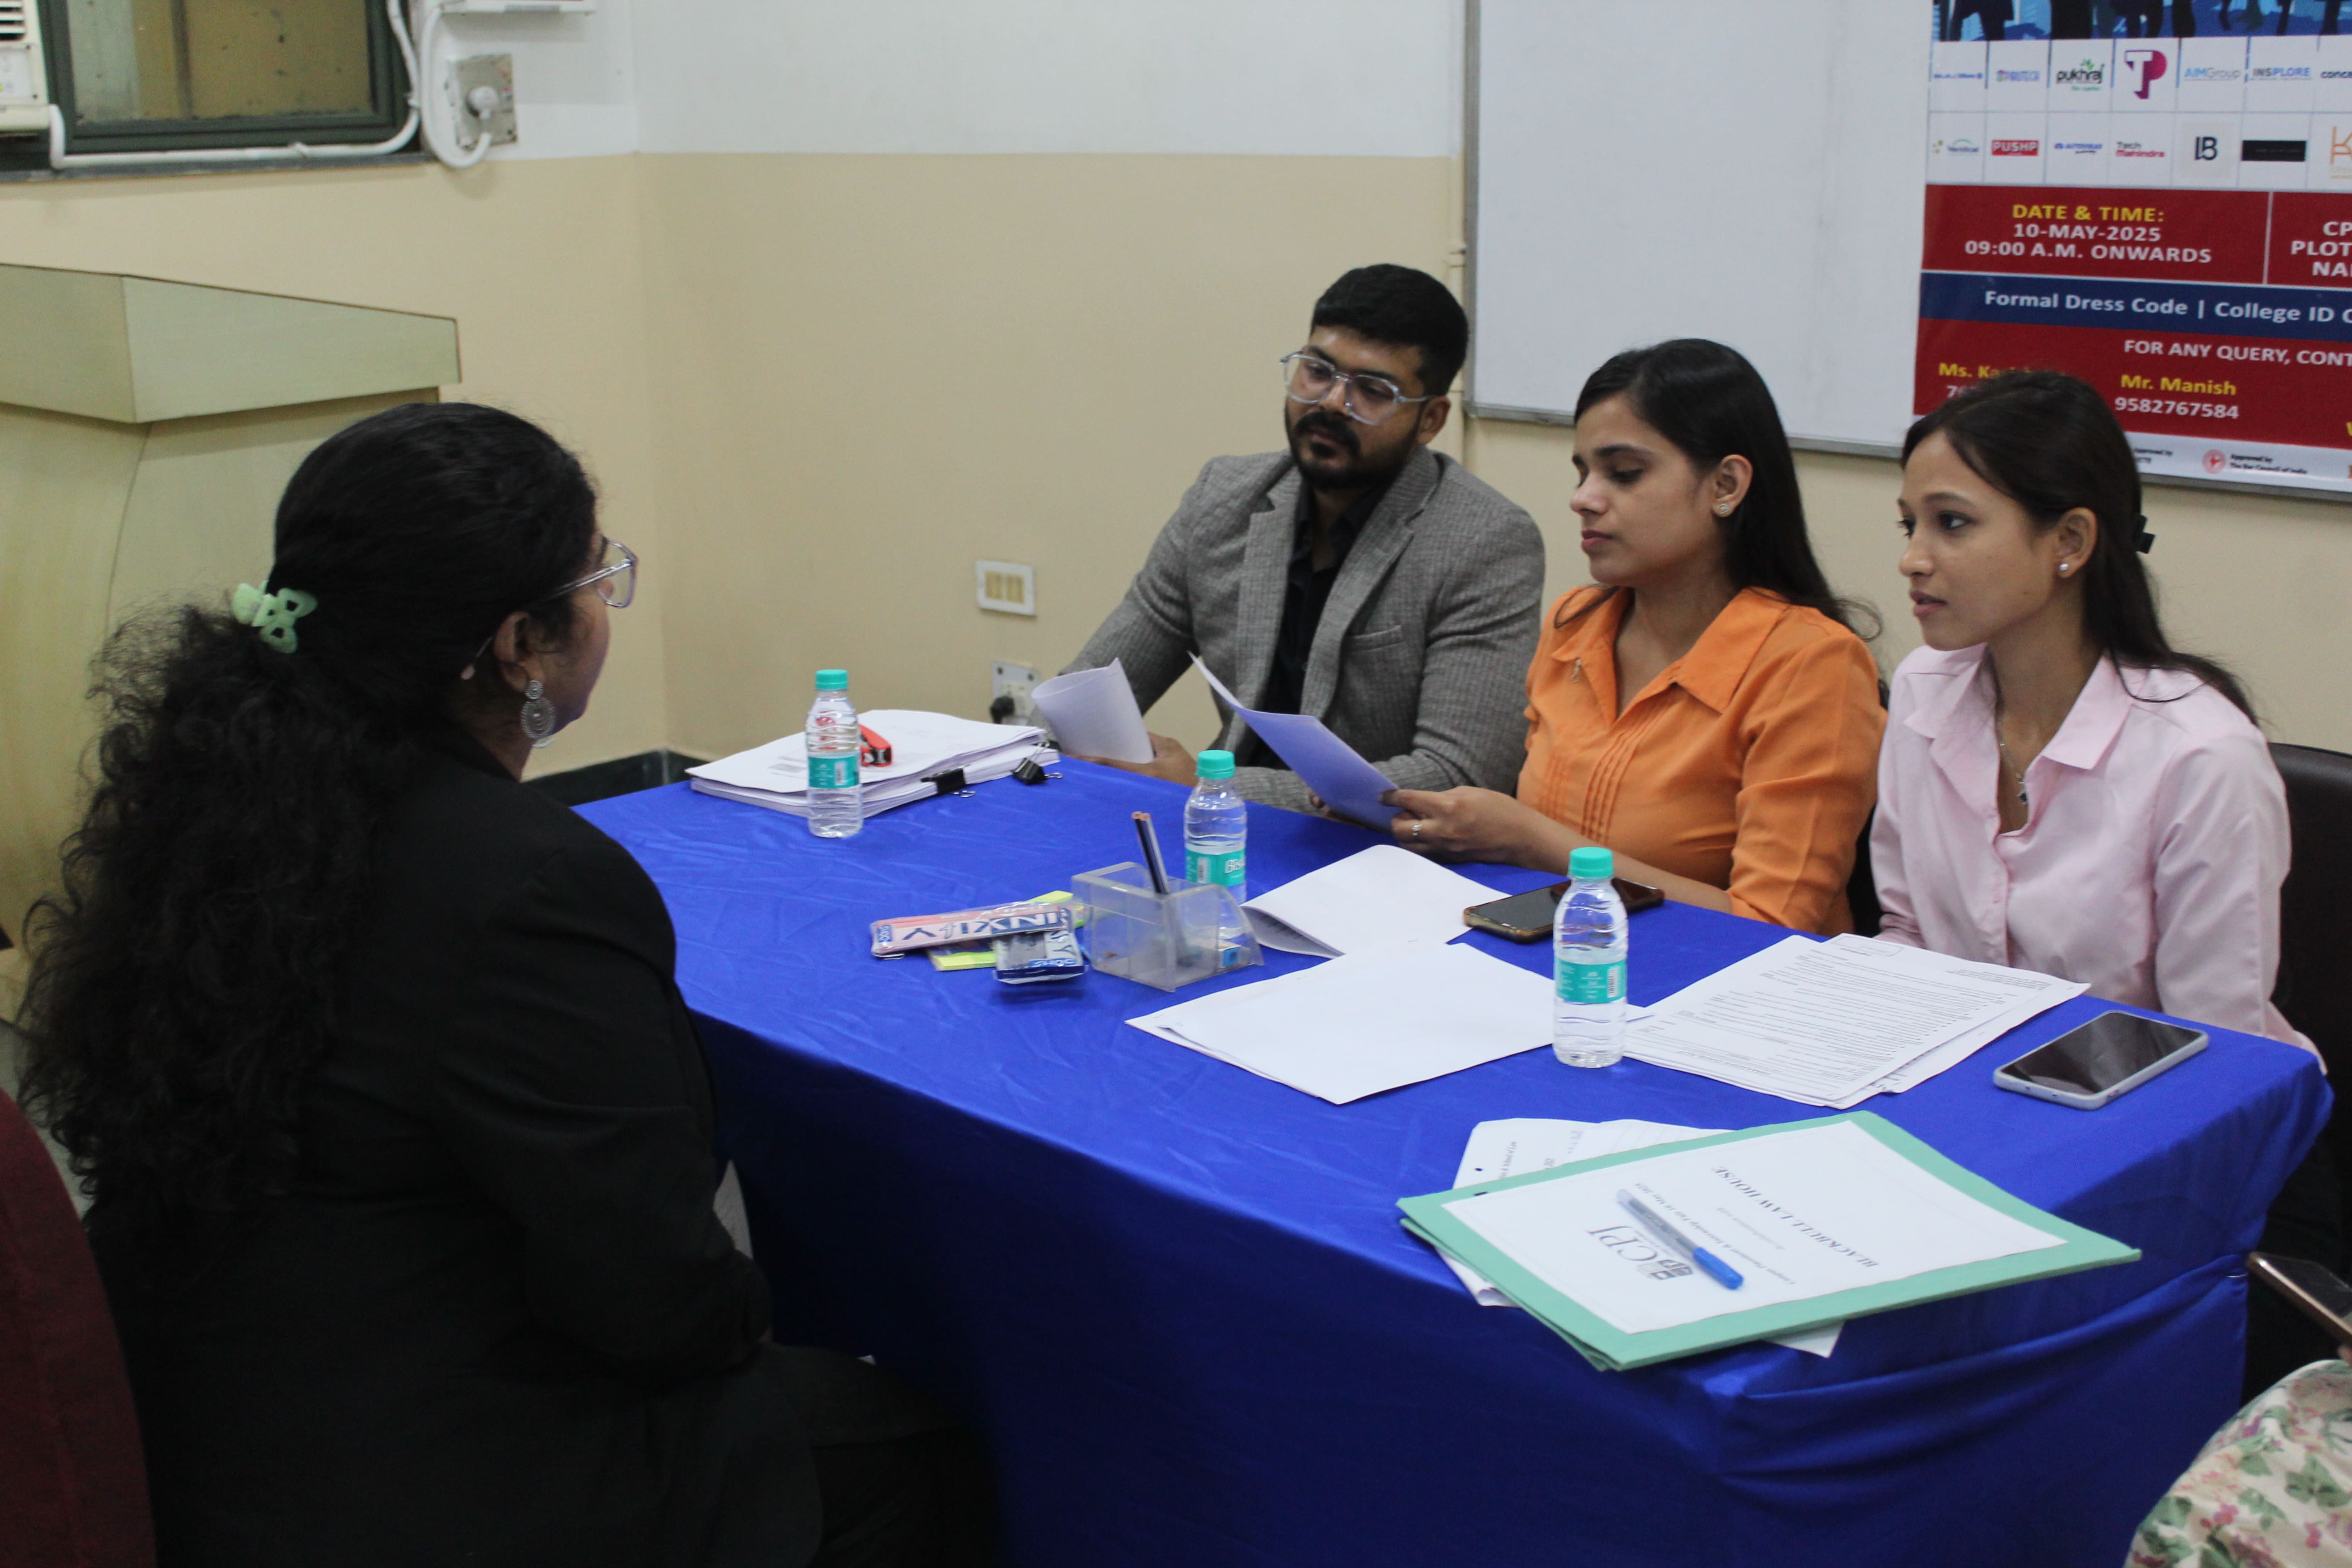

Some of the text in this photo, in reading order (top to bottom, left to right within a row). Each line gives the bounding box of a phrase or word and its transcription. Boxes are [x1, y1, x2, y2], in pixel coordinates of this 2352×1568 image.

[1993, 141, 2038, 152] PUSHP
[2012, 204, 2164, 222] DATE & TIME:
[2014, 223, 2161, 242] 10-MAY-2025
[1965, 240, 2212, 264] 09:00 A.M. ONWARDS
[2291, 240, 2352, 257] PLOT
[2312, 261, 2352, 277] NA
[1985, 290, 2059, 309] Formal
[2065, 294, 2125, 312] Dress
[2131, 297, 2188, 315] Code
[2215, 301, 2301, 324] College
[2308, 306, 2335, 322] ID
[2124, 339, 2163, 355] FOR
[2168, 343, 2212, 358] ANY
[2216, 345, 2291, 365] QUERY,
[1939, 362, 1973, 377] Ms.
[2121, 374, 2237, 396] Mr. Manish
[2114, 397, 2239, 419] 9582767584
[1711, 1166, 1879, 1267] BLACKBULL LAW HOUSE
[1585, 1225, 1658, 1261] CPJ
